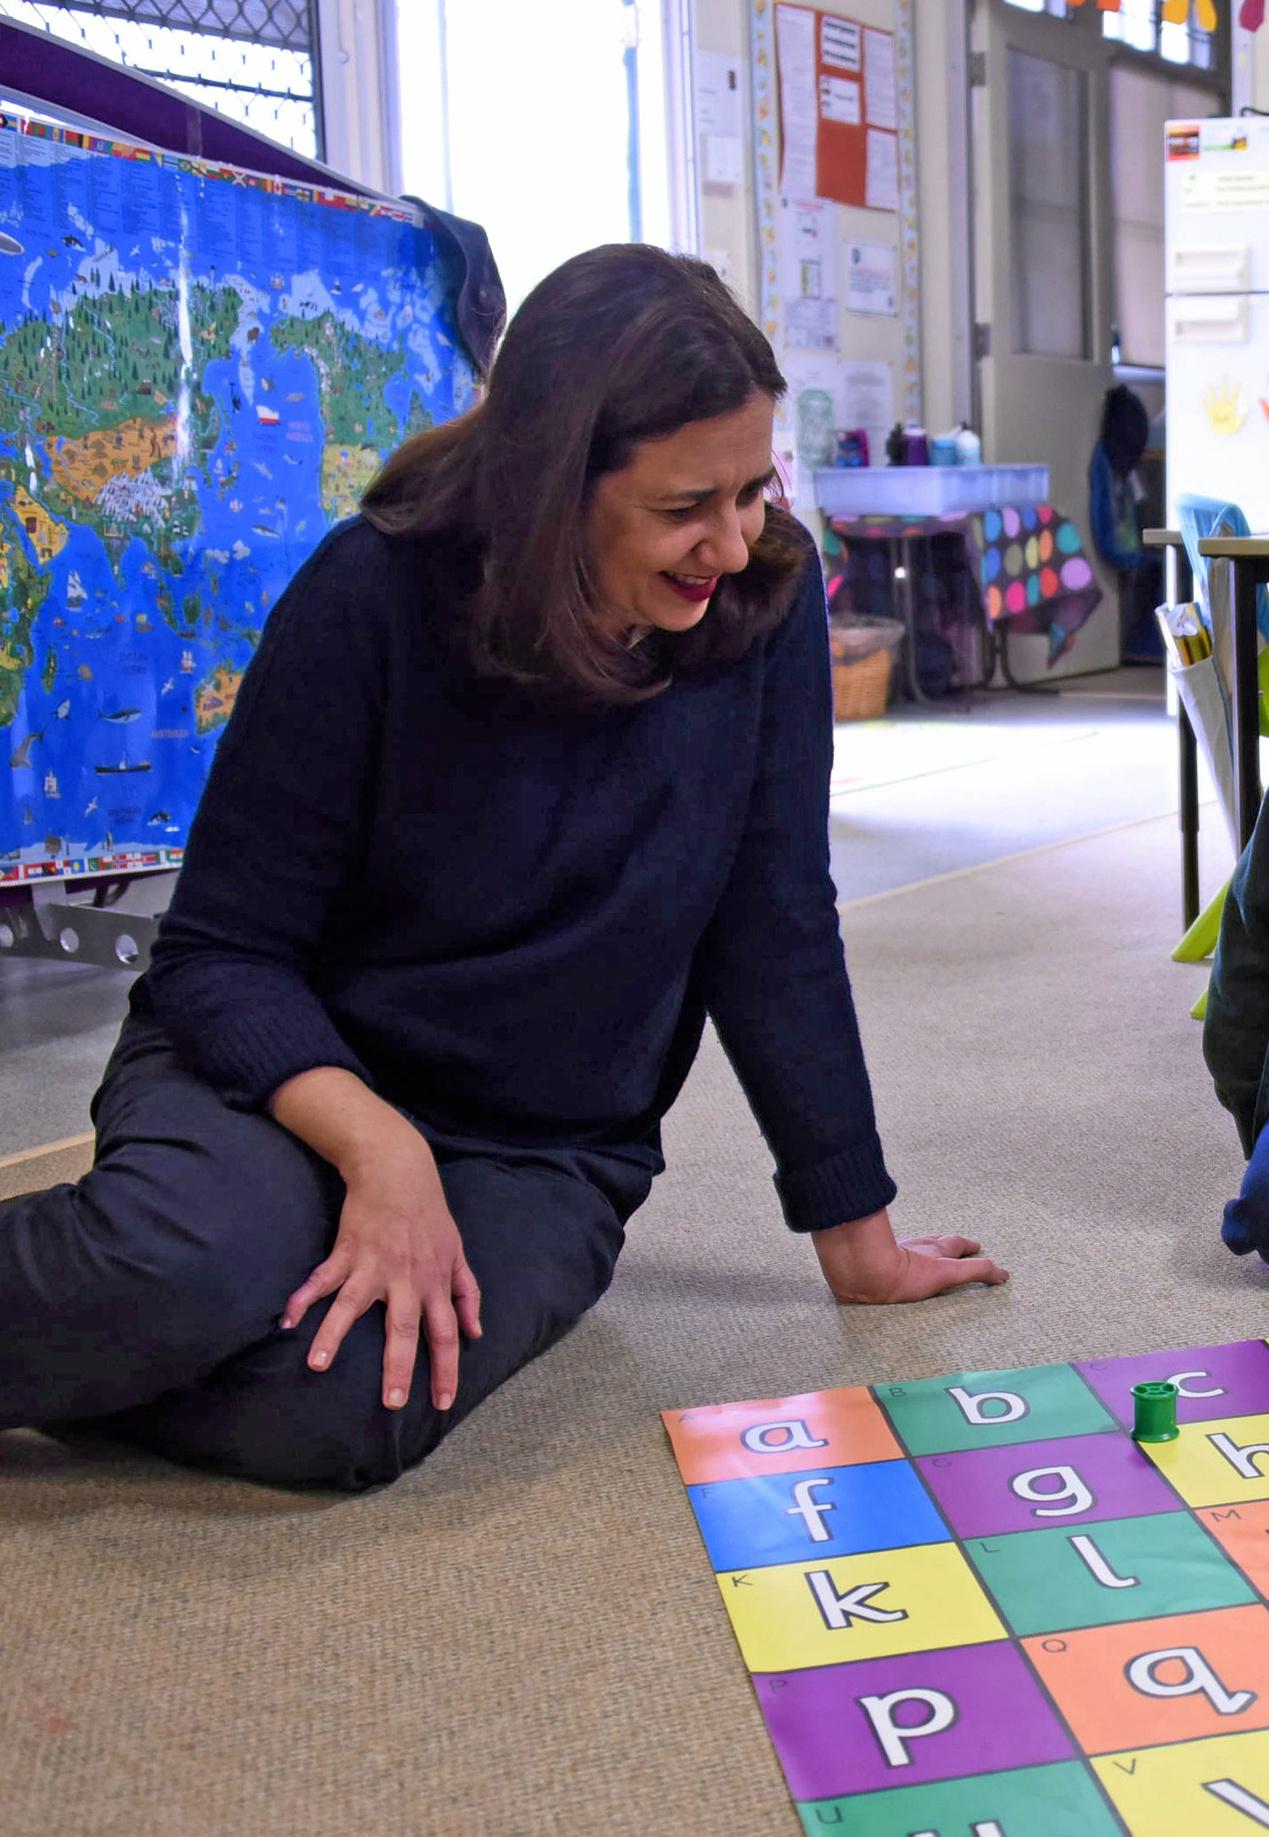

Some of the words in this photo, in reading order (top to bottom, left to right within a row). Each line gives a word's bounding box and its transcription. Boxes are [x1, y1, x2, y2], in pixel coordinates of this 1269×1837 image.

[889, 1387, 907, 1398] B
[1167, 1370, 1227, 1399] c
[945, 1386, 1031, 1425] b
[741, 1419, 830, 1453] a
[1009, 1465, 1096, 1517] g
[785, 1477, 836, 1543] f
[1210, 1509, 1242, 1522] M
[1067, 1534, 1141, 1590] l
[731, 1575, 753, 1588] K
[804, 1570, 908, 1630] k
[1042, 1638, 1067, 1653] Q
[1123, 1646, 1259, 1716] q
[855, 1686, 961, 1769] p
[1112, 1758, 1137, 1776] V
[815, 1805, 843, 1825] U
